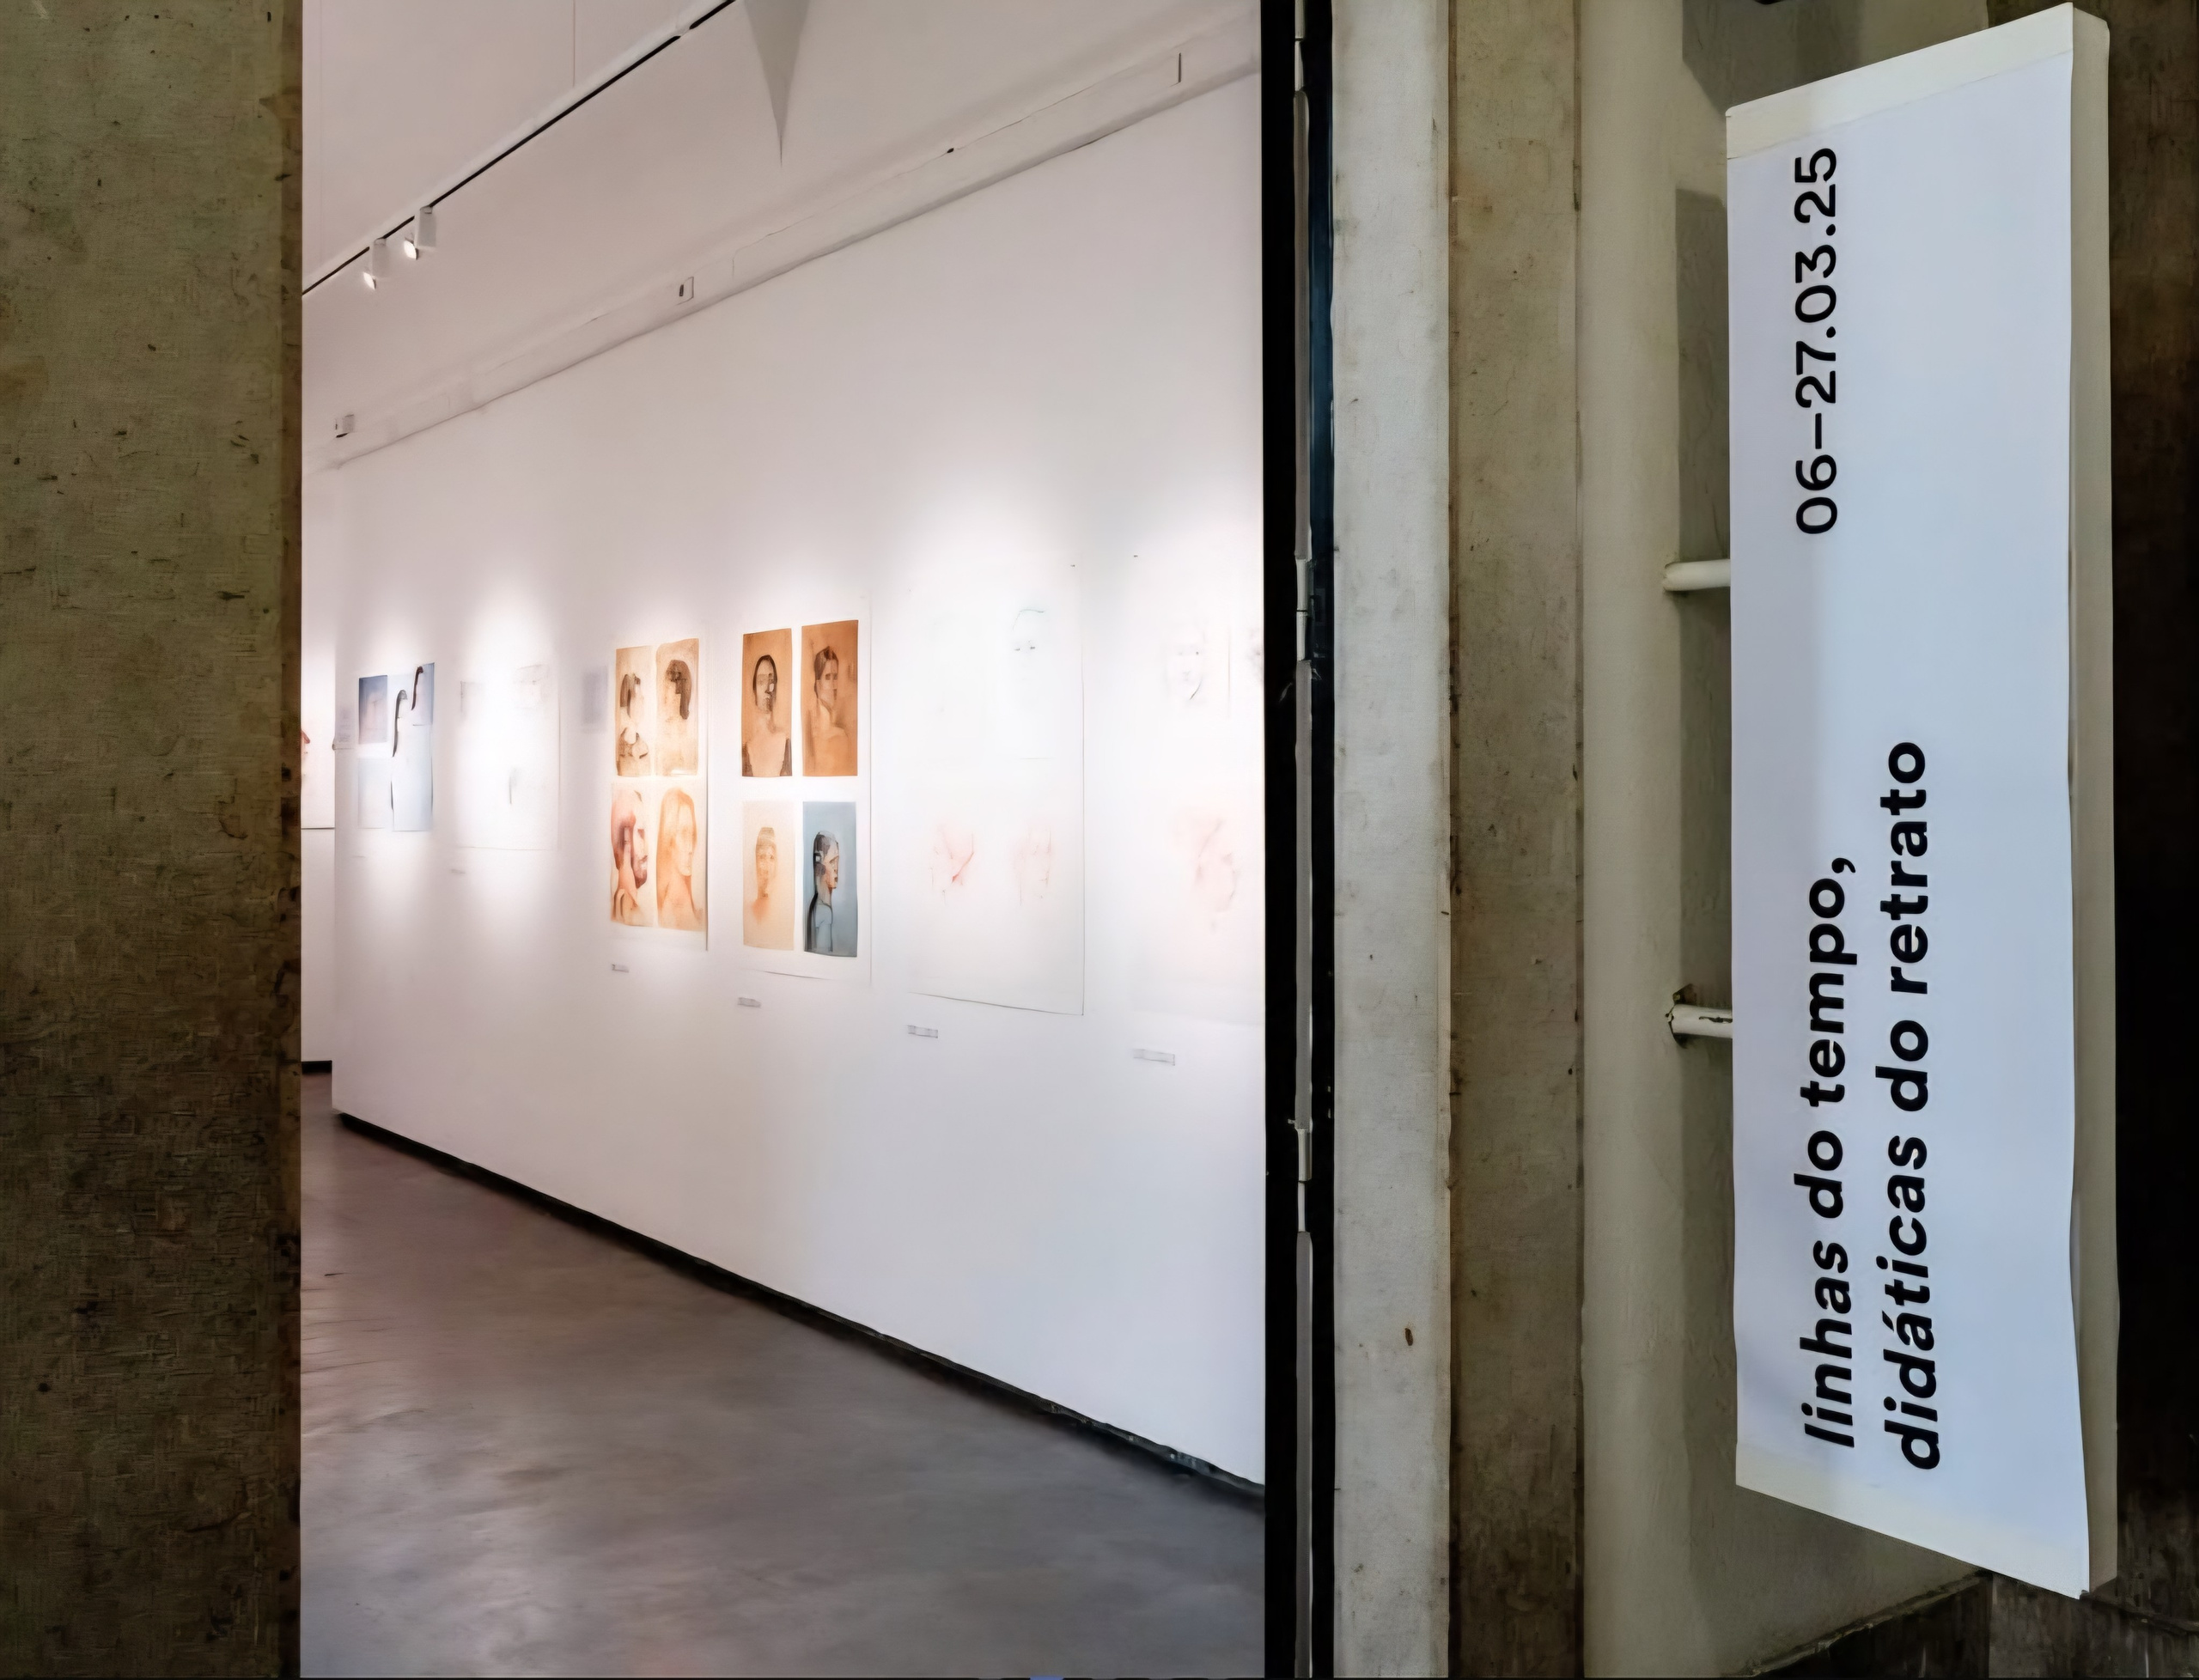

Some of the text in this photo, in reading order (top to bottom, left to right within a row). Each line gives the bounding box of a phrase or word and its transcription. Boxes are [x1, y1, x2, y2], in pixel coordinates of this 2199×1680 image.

[1793, 857, 1858, 1449] linhas do tempo,
[1874, 741, 1940, 1470] didáticas do retrato
